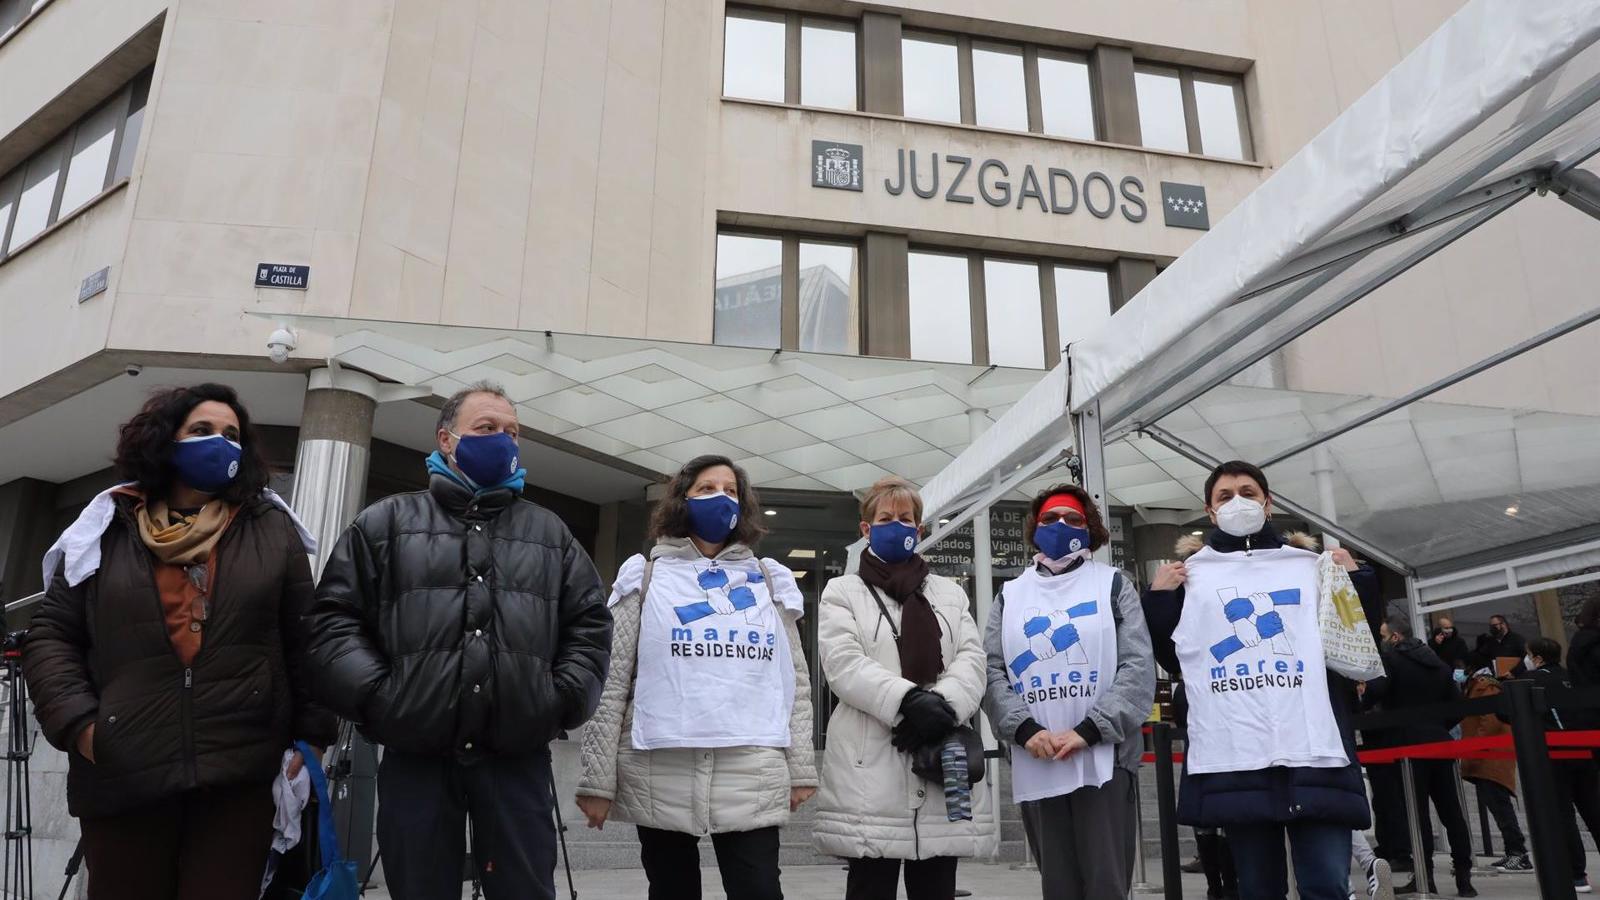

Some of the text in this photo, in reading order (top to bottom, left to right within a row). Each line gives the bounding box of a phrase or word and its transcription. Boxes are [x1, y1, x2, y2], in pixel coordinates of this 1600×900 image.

[885, 149, 1148, 223] JUZGADOS
[272, 265, 287, 273] PLAZA
[270, 275, 302, 285] CASTILLA
[1003, 512, 1021, 523] DE
[1008, 527, 1022, 537] de
[671, 627, 775, 645] marea
[671, 643, 774, 661] RESIDENCIAS
[1210, 659, 1304, 679] marea
